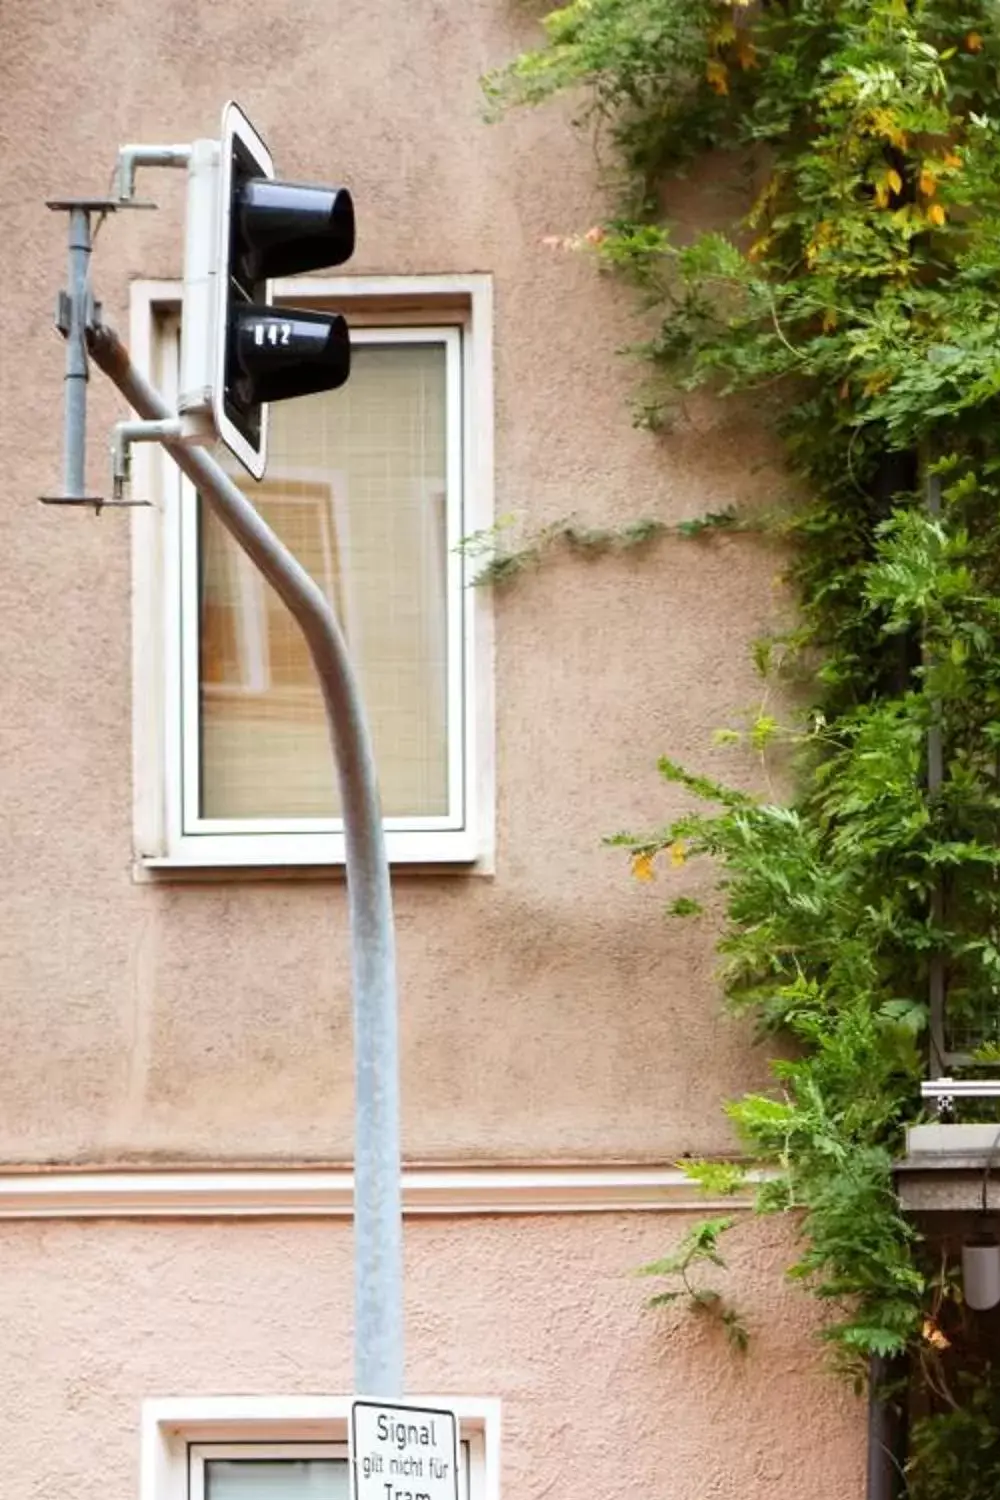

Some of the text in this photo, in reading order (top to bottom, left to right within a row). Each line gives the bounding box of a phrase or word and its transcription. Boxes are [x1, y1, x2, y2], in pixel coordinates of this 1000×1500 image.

[377, 1413, 437, 1450] Signal
[363, 1452, 383, 1479] gilt
[389, 1456, 423, 1477] nicht
